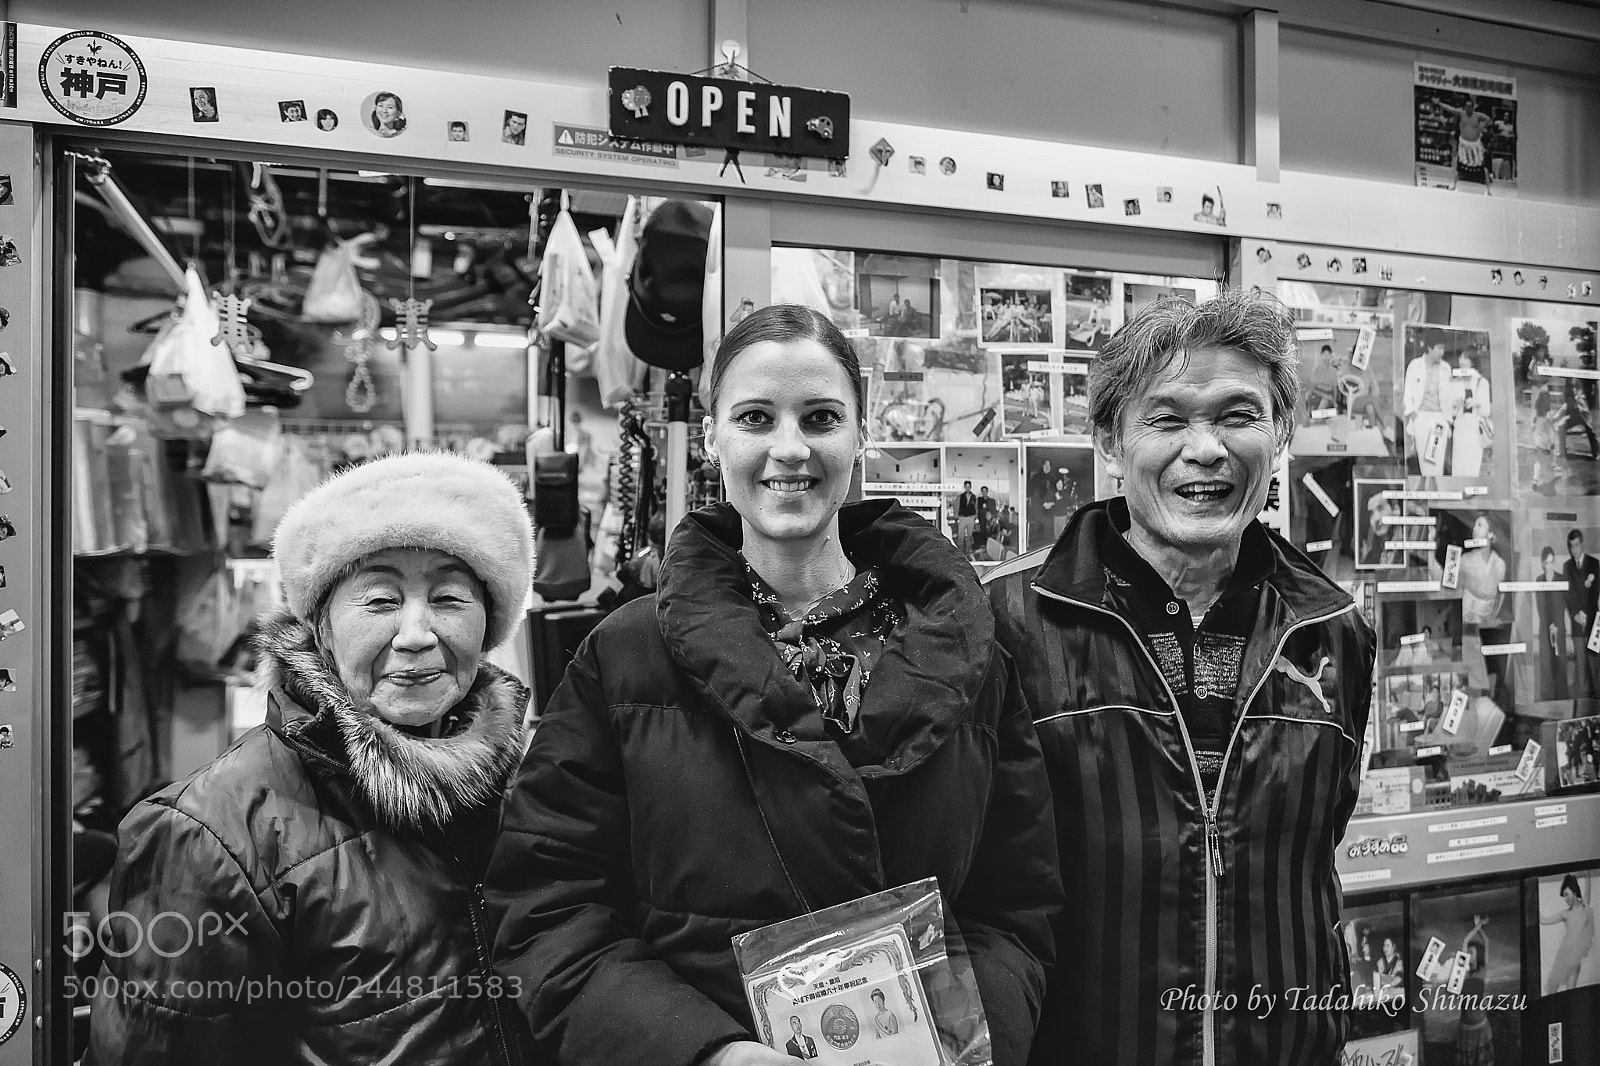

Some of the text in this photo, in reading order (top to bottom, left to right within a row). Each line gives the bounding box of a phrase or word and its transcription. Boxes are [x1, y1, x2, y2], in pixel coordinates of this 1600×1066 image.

[64, 54, 123, 70] すきやねん!
[60, 67, 128, 100] 神戸
[666, 80, 792, 139] OPEN
[555, 147, 677, 167] SECURITY SYSTEM OPERATING
